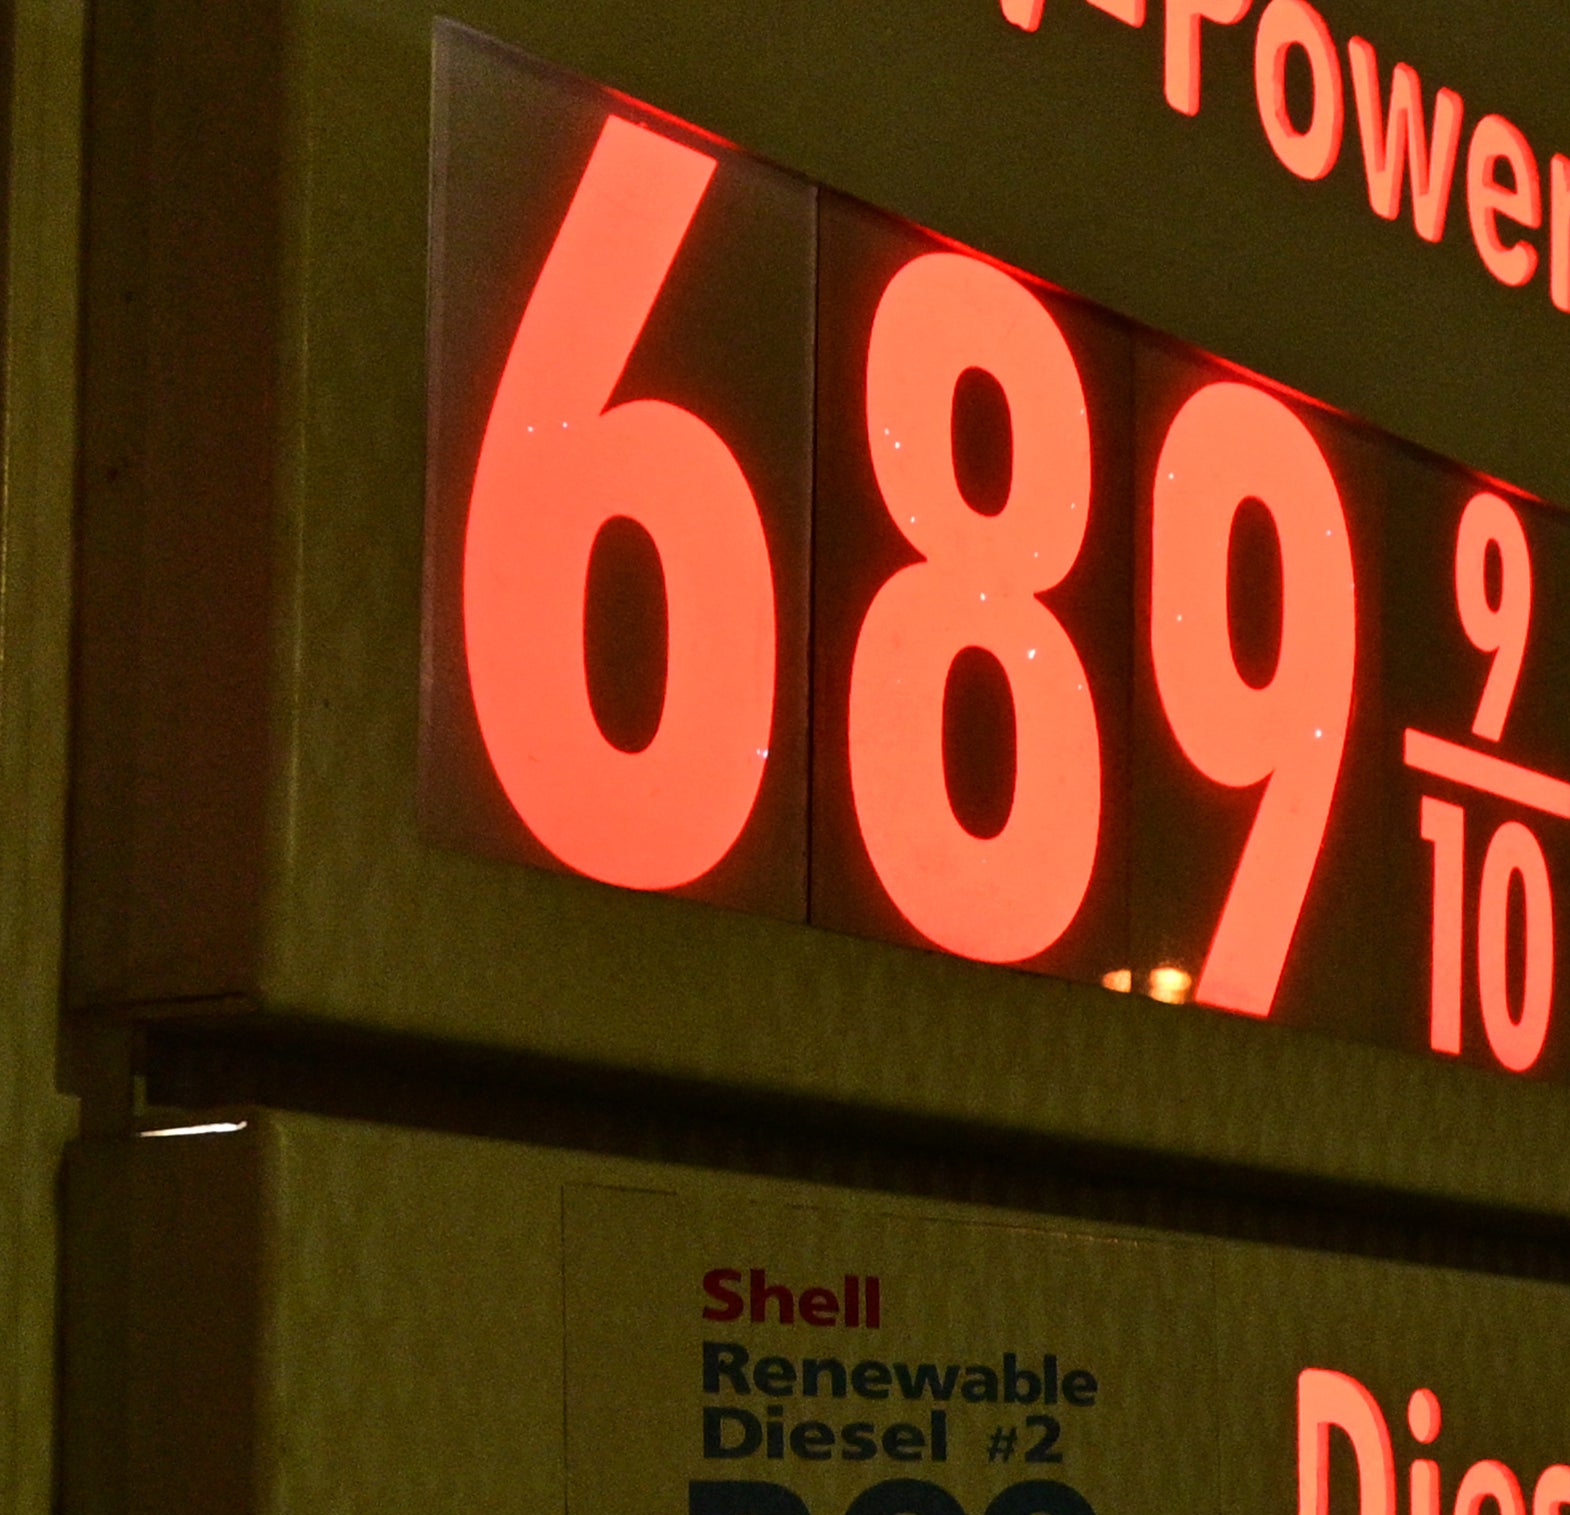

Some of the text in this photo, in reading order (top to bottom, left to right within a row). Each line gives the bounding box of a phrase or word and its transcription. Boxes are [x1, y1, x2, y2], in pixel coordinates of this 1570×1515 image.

[462, 112, 1360, 1019] 689
[702, 1267, 881, 1329] Shell
[702, 1341, 1099, 1406] Renewable
[703, 1404, 1064, 1464] Diesel #2
